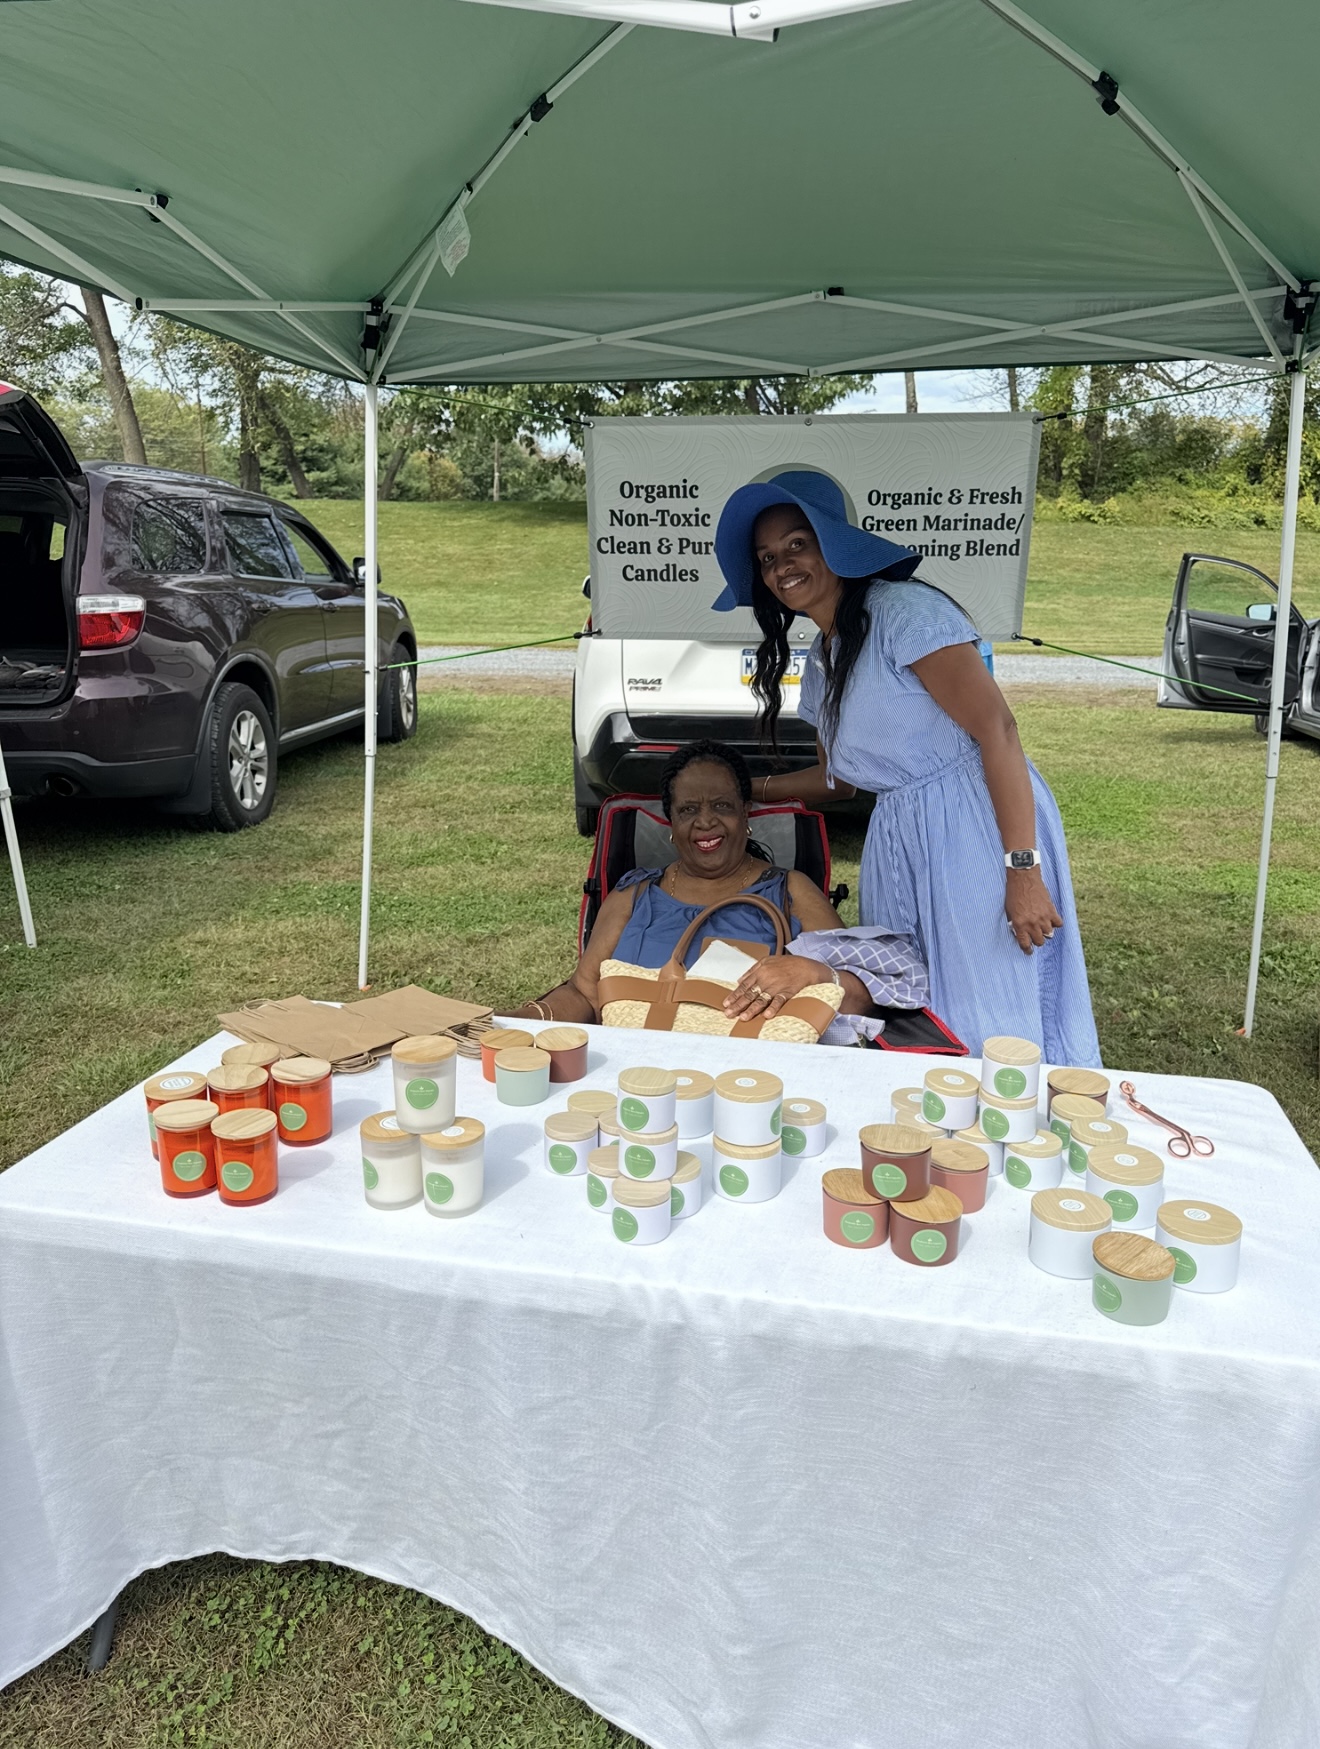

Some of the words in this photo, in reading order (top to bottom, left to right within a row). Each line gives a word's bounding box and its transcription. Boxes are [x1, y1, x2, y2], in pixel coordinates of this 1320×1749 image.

[619, 478, 699, 504] Organic
[867, 486, 943, 511] Organic
[947, 488, 965, 506] &
[968, 486, 1023, 505] Fresh
[608, 507, 711, 527] Non-Toxic
[861, 515, 918, 532] Green
[922, 512, 1026, 535] Marinade/
[596, 535, 652, 555] Clean
[656, 537, 674, 555] &
[677, 537, 715, 555] Pur
[899, 538, 962, 561] oning
[965, 538, 1021, 557] Blend
[621, 563, 700, 582] Candles
